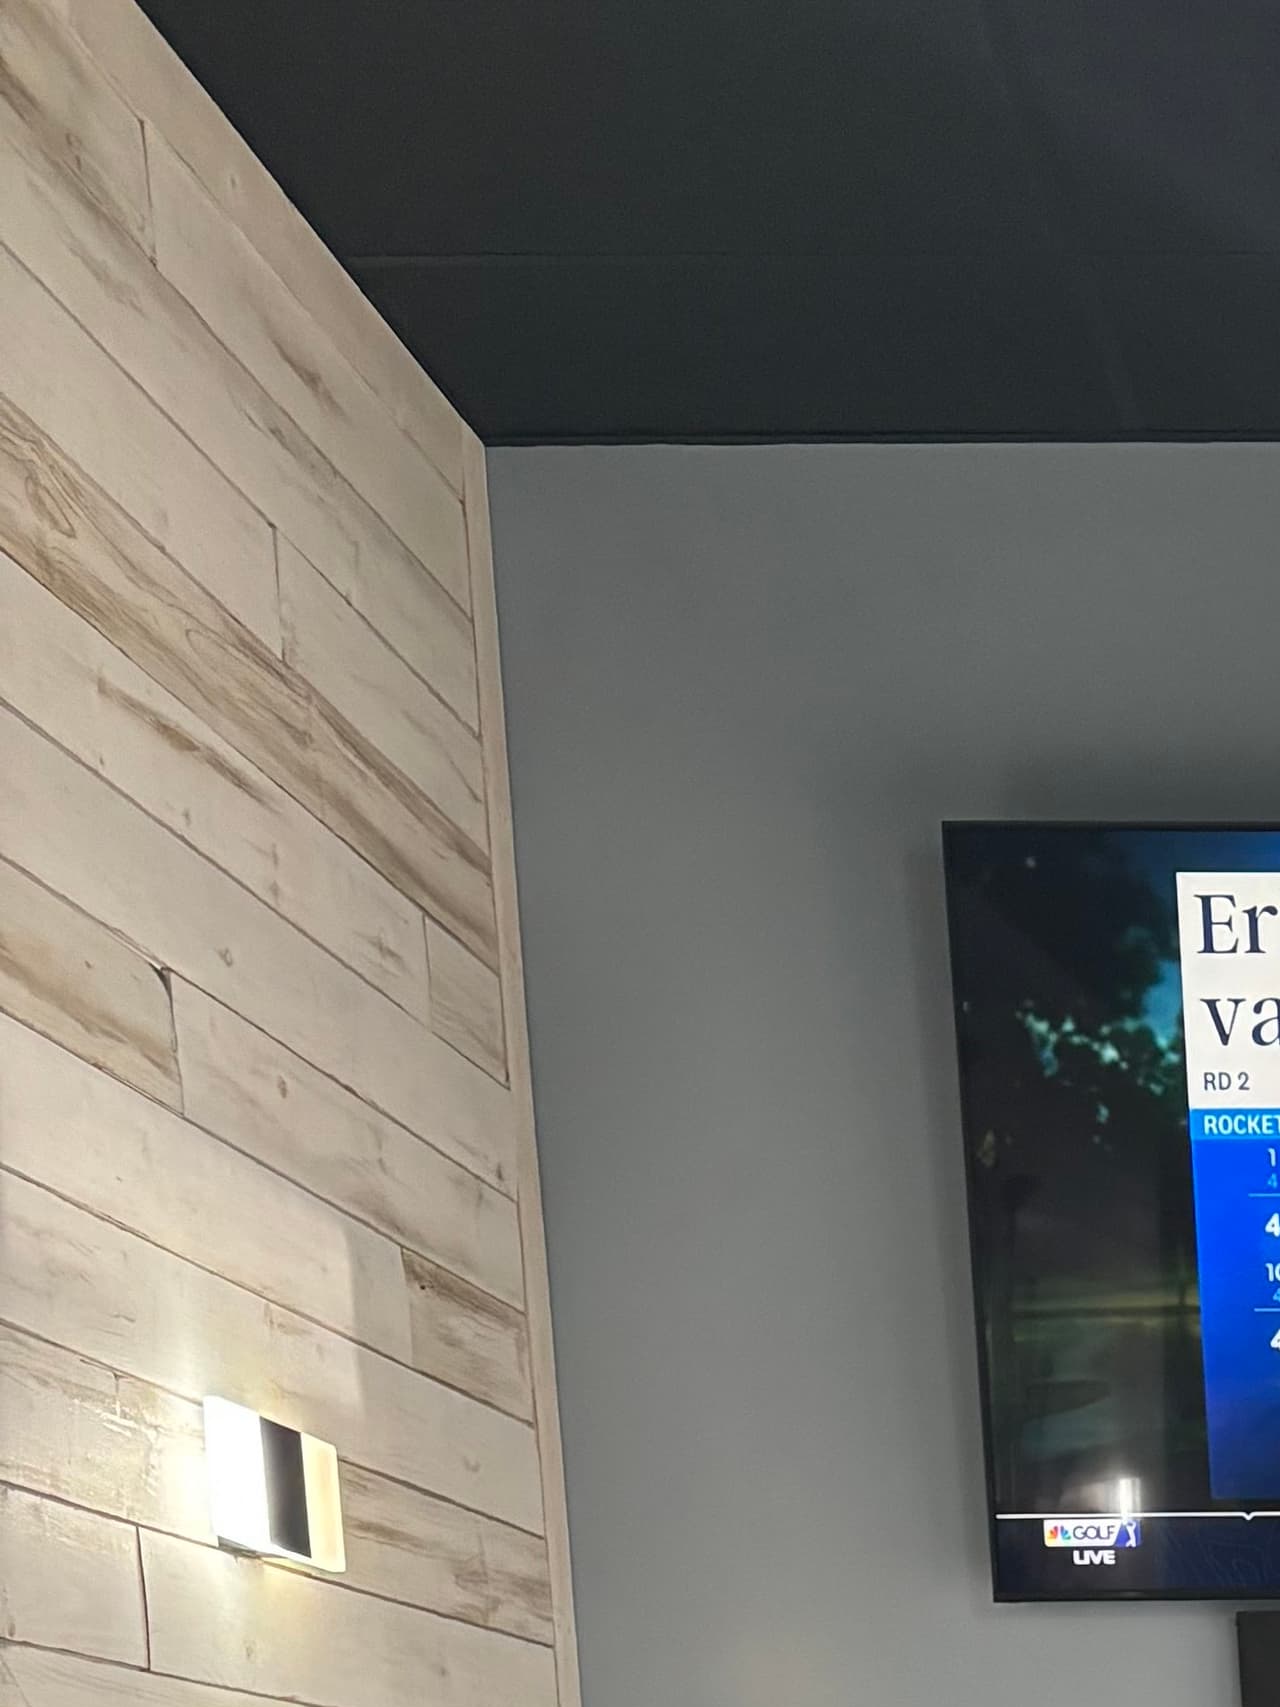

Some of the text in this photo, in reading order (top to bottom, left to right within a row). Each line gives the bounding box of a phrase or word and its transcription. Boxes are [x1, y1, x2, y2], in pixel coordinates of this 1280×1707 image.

[1203, 1072, 1251, 1091] RD 2
[1267, 1148, 1276, 1167] 1
[1267, 1173, 1278, 1188] 4
[1073, 1525, 1116, 1540] GOLF
[1073, 1549, 1116, 1565] LIVE
